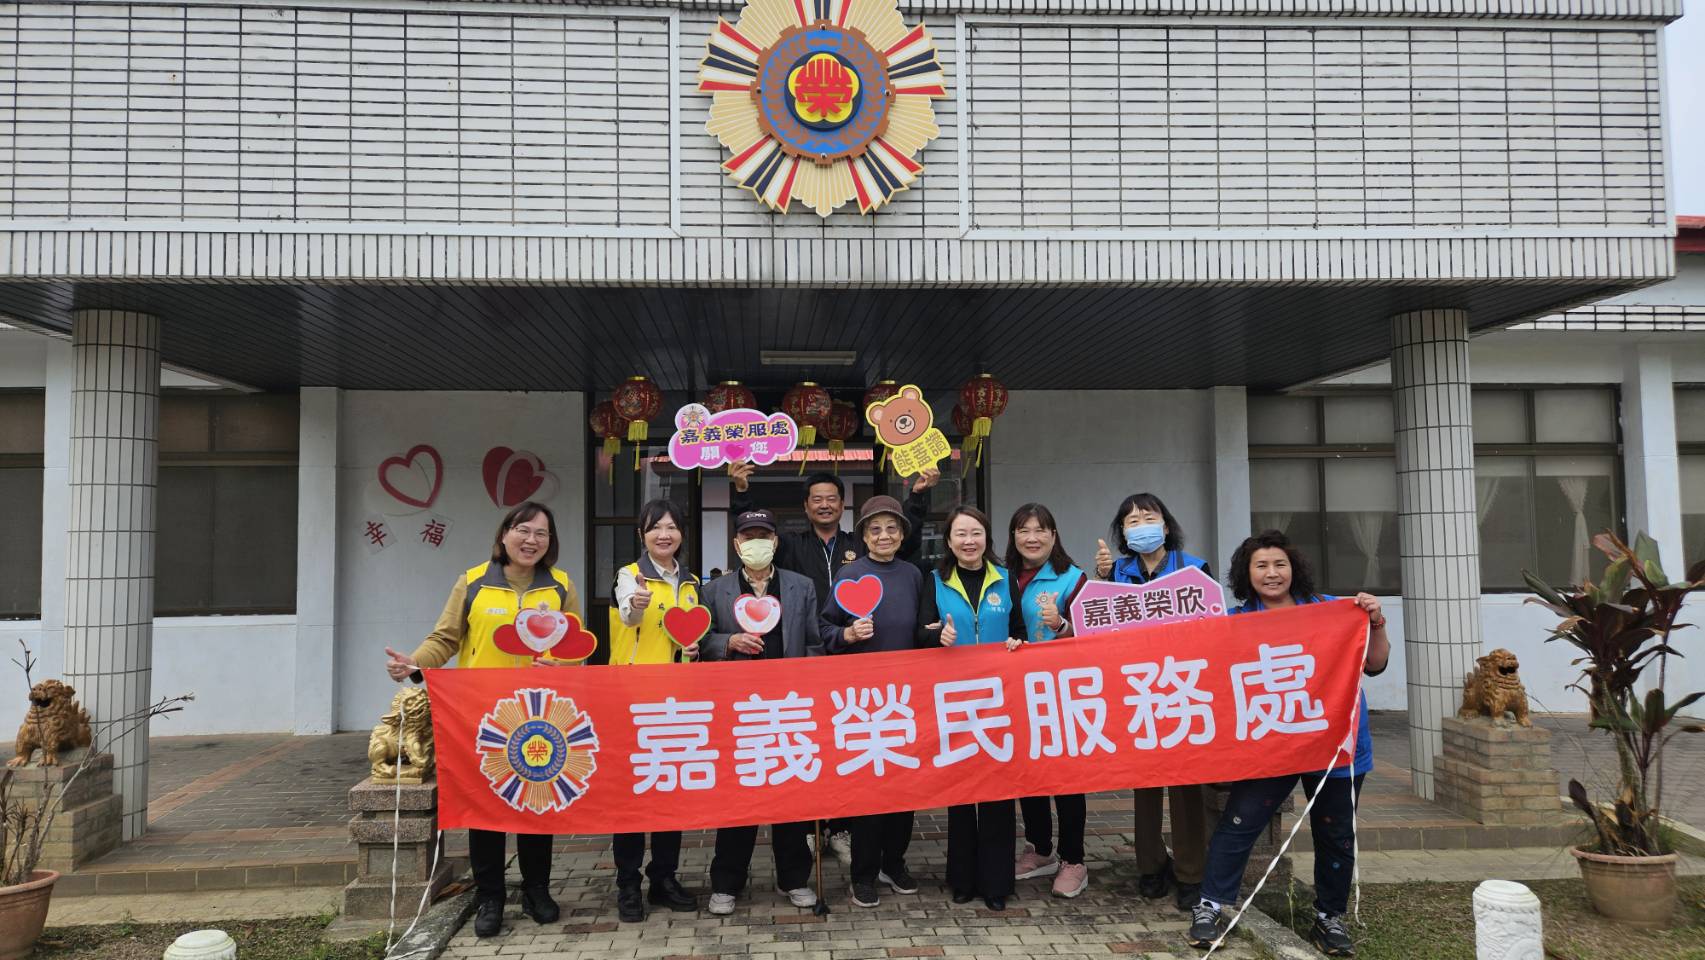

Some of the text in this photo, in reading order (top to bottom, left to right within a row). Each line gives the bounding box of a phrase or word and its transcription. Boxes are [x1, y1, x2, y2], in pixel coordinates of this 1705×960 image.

[681, 420, 789, 444] 嘉義榮服處
[1081, 585, 1206, 628] 嘉義榮欣
[629, 643, 1329, 795] 嘉義榮民服務處
